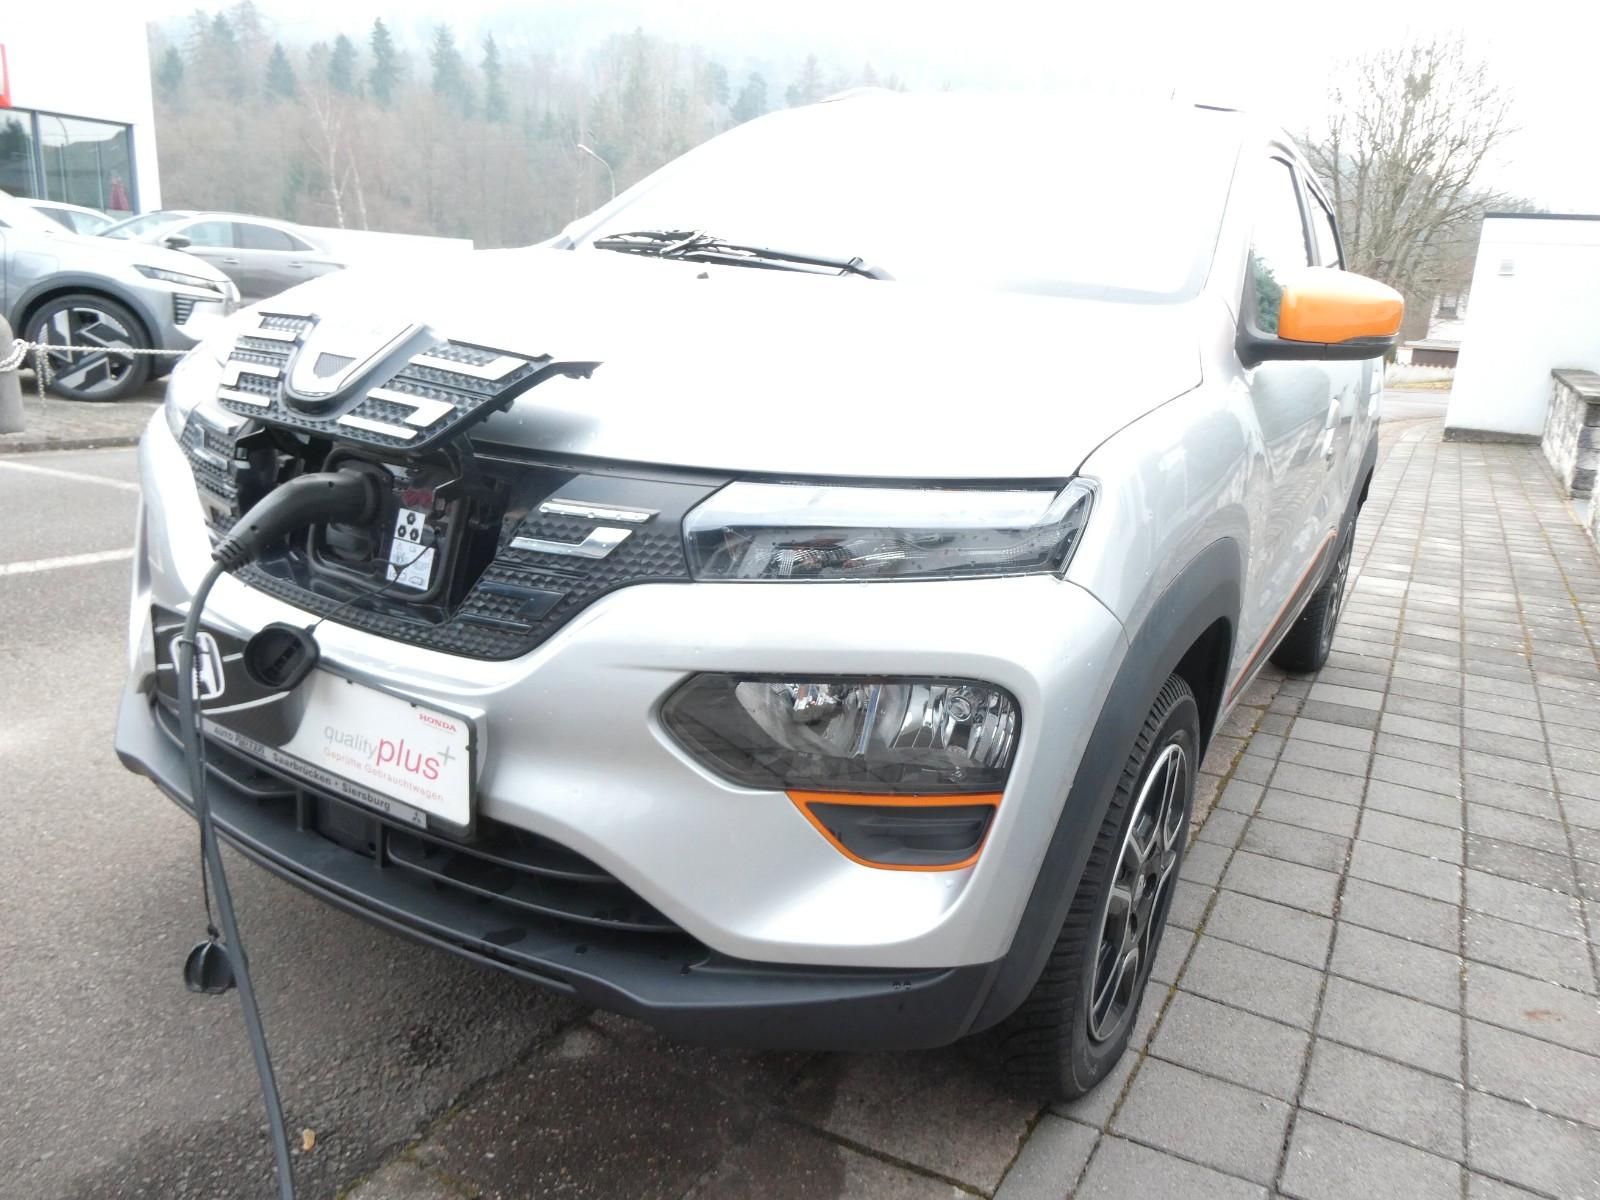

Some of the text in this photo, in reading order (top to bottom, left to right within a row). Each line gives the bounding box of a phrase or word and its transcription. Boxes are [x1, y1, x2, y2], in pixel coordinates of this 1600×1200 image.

[418, 712, 457, 733] HONDA
[272, 751, 332, 786] Saarbrücken
[341, 782, 392, 812] Siersburg
[364, 760, 445, 801] Gebrauchtwagen
